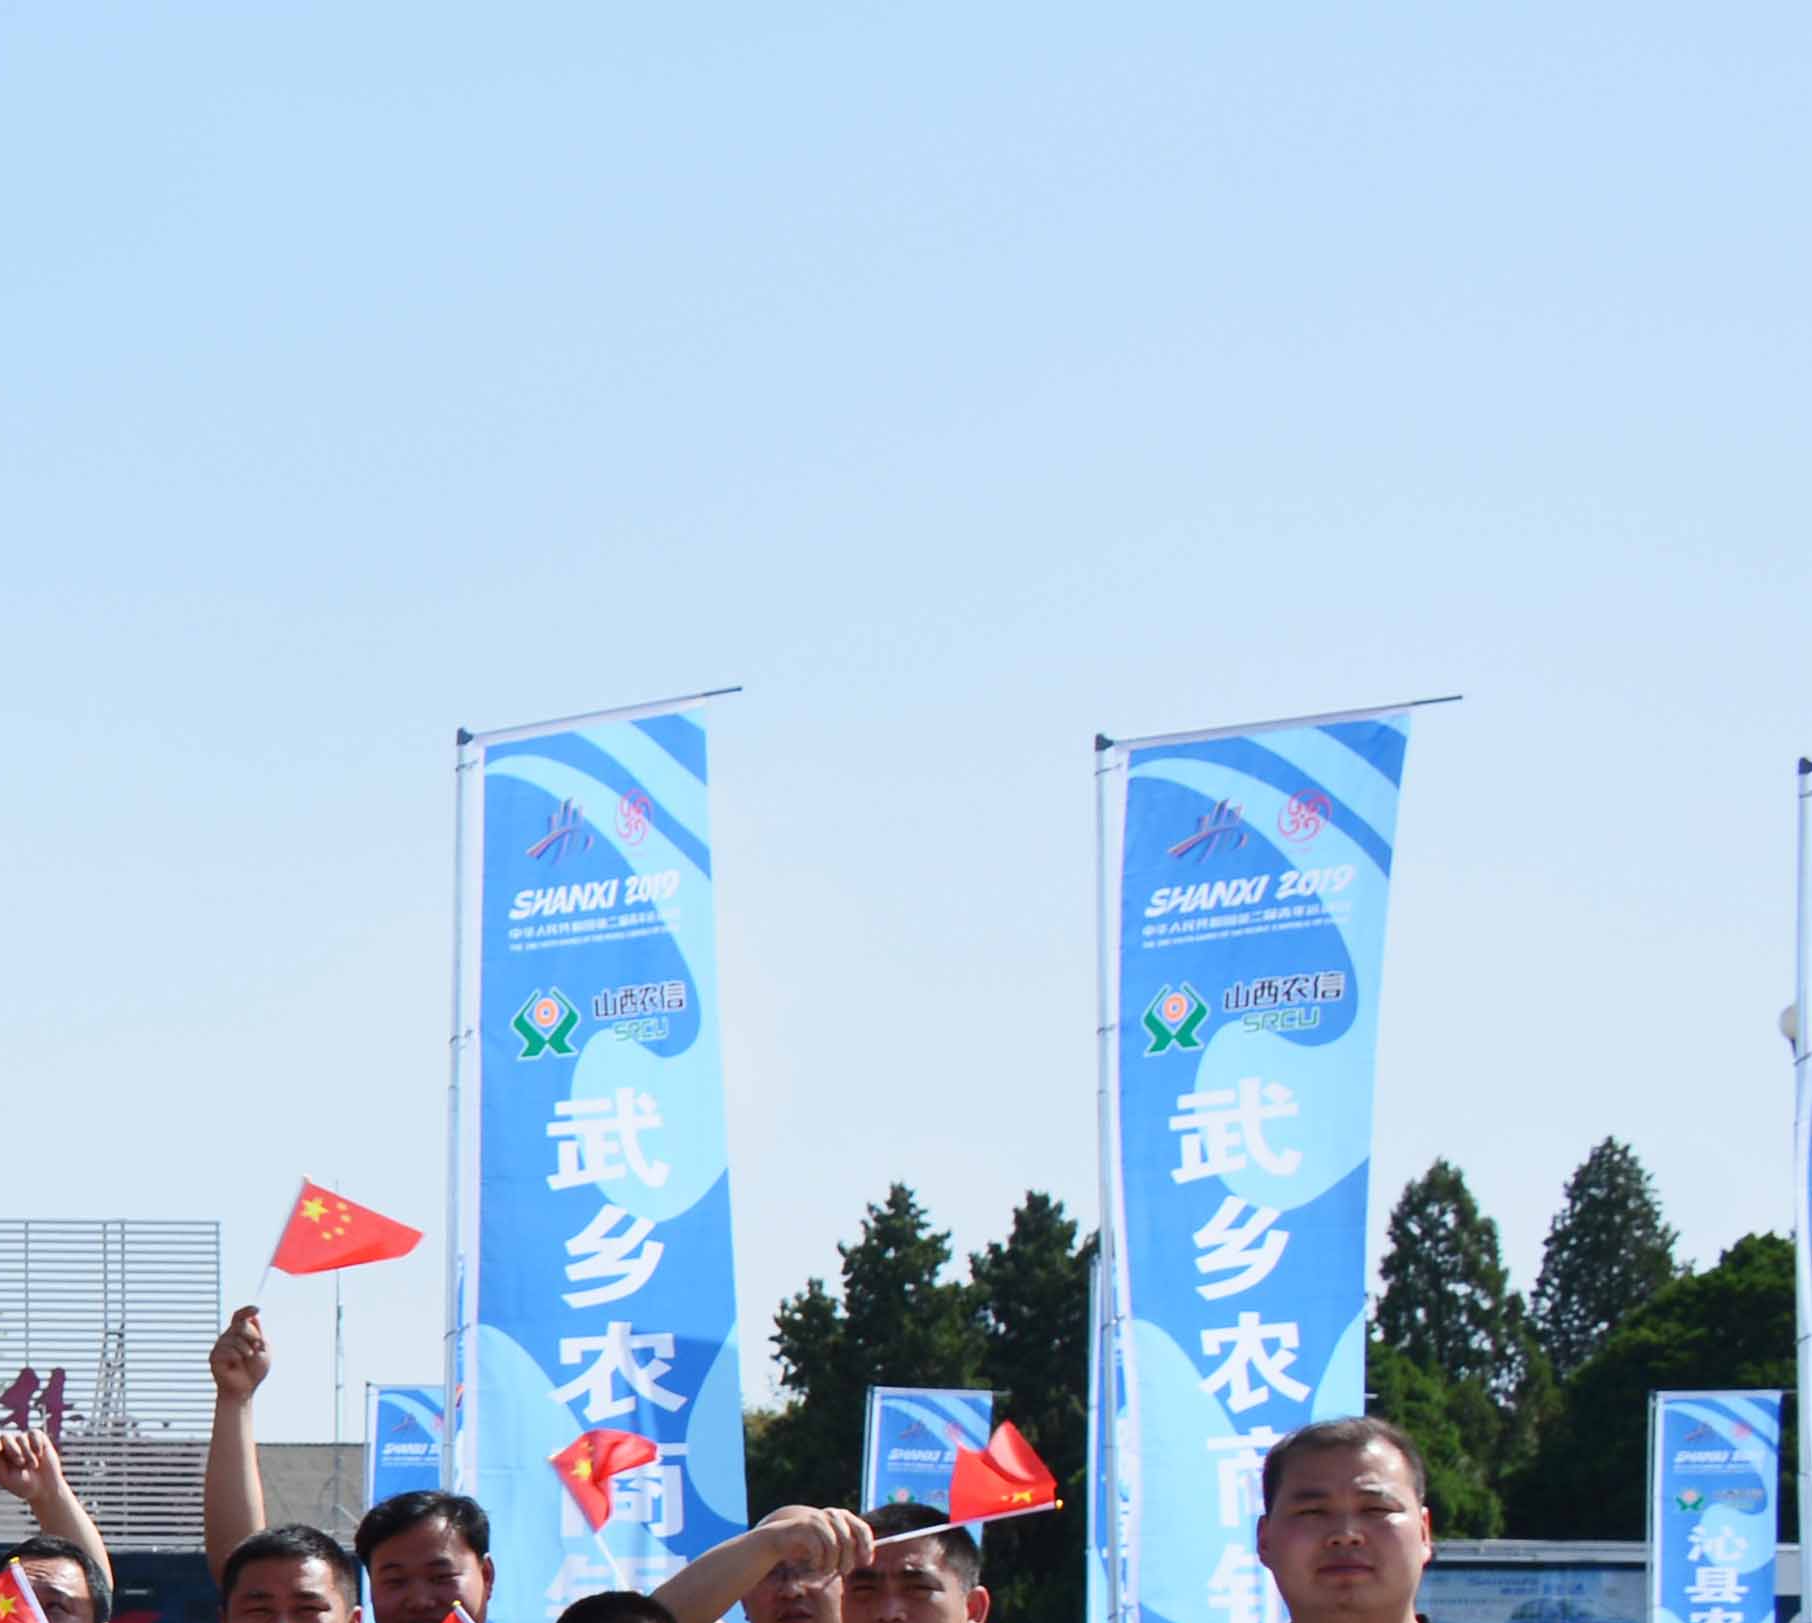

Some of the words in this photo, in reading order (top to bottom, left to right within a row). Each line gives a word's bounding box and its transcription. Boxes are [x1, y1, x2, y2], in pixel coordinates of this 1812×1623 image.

[509, 878, 620, 921] SHANXI
[1144, 874, 1271, 918] SHANXI
[1274, 864, 1355, 901] 2019
[594, 982, 685, 1018] 山西农信
[1224, 971, 1344, 1012] 山西农信
[614, 1016, 669, 1043] SRCU
[1242, 1007, 1320, 1033] SRCU
